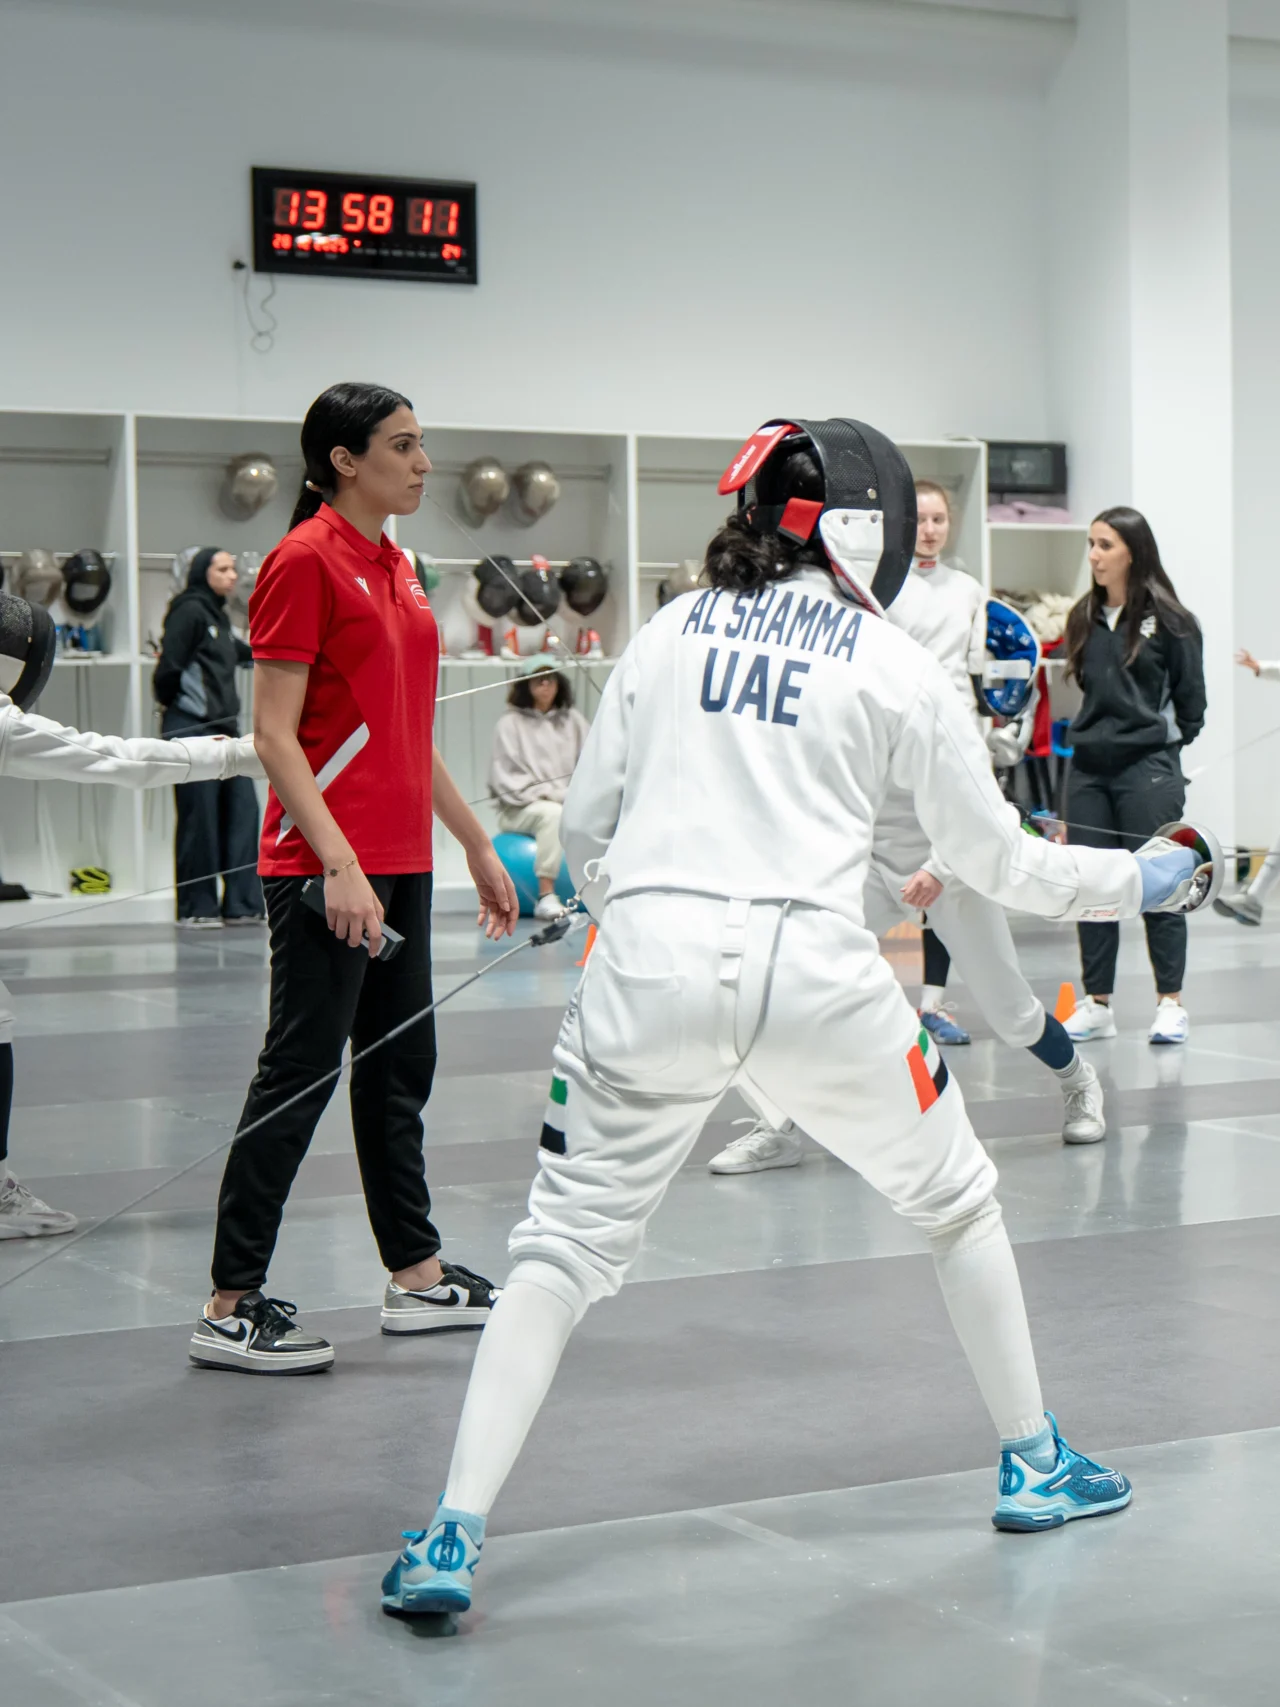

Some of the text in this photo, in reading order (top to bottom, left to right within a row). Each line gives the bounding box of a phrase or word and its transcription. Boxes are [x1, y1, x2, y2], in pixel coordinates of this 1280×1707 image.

[288, 190, 460, 236] 13 58 11
[681, 588, 863, 663] AL SHAMMA
[700, 647, 811, 728] UAE
